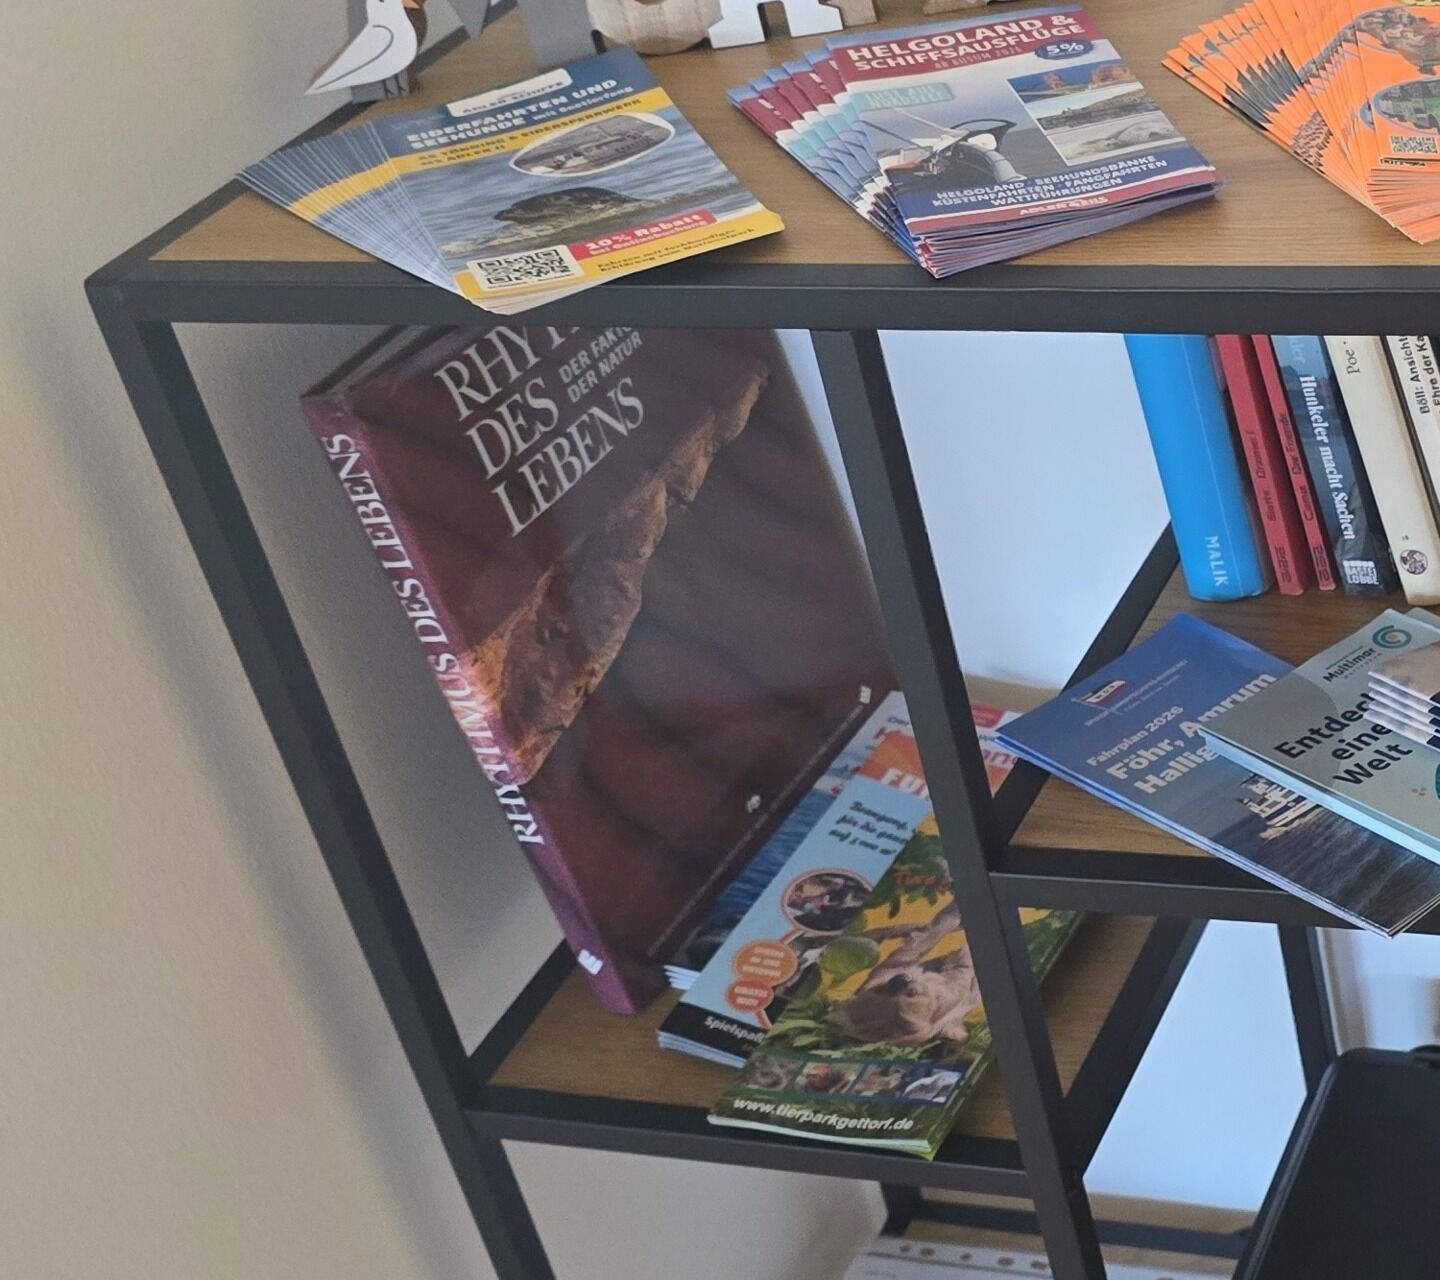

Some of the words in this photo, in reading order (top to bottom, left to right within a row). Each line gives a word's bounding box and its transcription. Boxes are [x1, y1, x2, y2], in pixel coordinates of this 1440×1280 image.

[847, 18, 1043, 62] HELGOLAND
[1051, 15, 1078, 26] &
[854, 24, 1086, 71] SCHIFFSAUSFLÜGE
[1045, 41, 1085, 55] 5%
[407, 96, 568, 142] EIDERFAHRTEN
[573, 79, 617, 100] UND
[410, 117, 527, 150] SEEHUNDE
[932, 184, 1054, 208] KÜSTENFAHRTEN
[1064, 160, 1167, 188] FANGFAHRTEN
[936, 181, 1025, 199] HELGOLAND
[1035, 155, 1157, 185] SEEHUNDSBÄNKE
[990, 177, 1123, 206] WATTFÜHRUNGEN
[635, 214, 703, 237] Rabatt
[558, 350, 591, 384] DER
[567, 371, 599, 403] DER
[599, 331, 643, 377] NATUR
[1347, 348, 1360, 376] Poe
[1422, 351, 1437, 377] der
[1414, 387, 1431, 415] Böll:
[465, 376, 559, 480] DES
[491, 376, 644, 537] LEBENS
[1300, 374, 1330, 443] Hunkeler
[1320, 445, 1344, 490] macht
[1332, 491, 1356, 540] Sachen
[321, 433, 414, 570] LEBENS
[1205, 535, 1230, 587] MALIK
[392, 577, 449, 644] DES
[427, 653, 544, 845] RHYTHMUS
[1086, 730, 1148, 767] Fahrplan
[1145, 705, 1184, 733] 2026
[1106, 737, 1185, 780] Föhr,
[1178, 673, 1278, 738] Amrum
[1331, 723, 1393, 761] eine
[1332, 744, 1414, 785] Welt
[733, 1097, 914, 1131] www.tierparkgettorf.de
